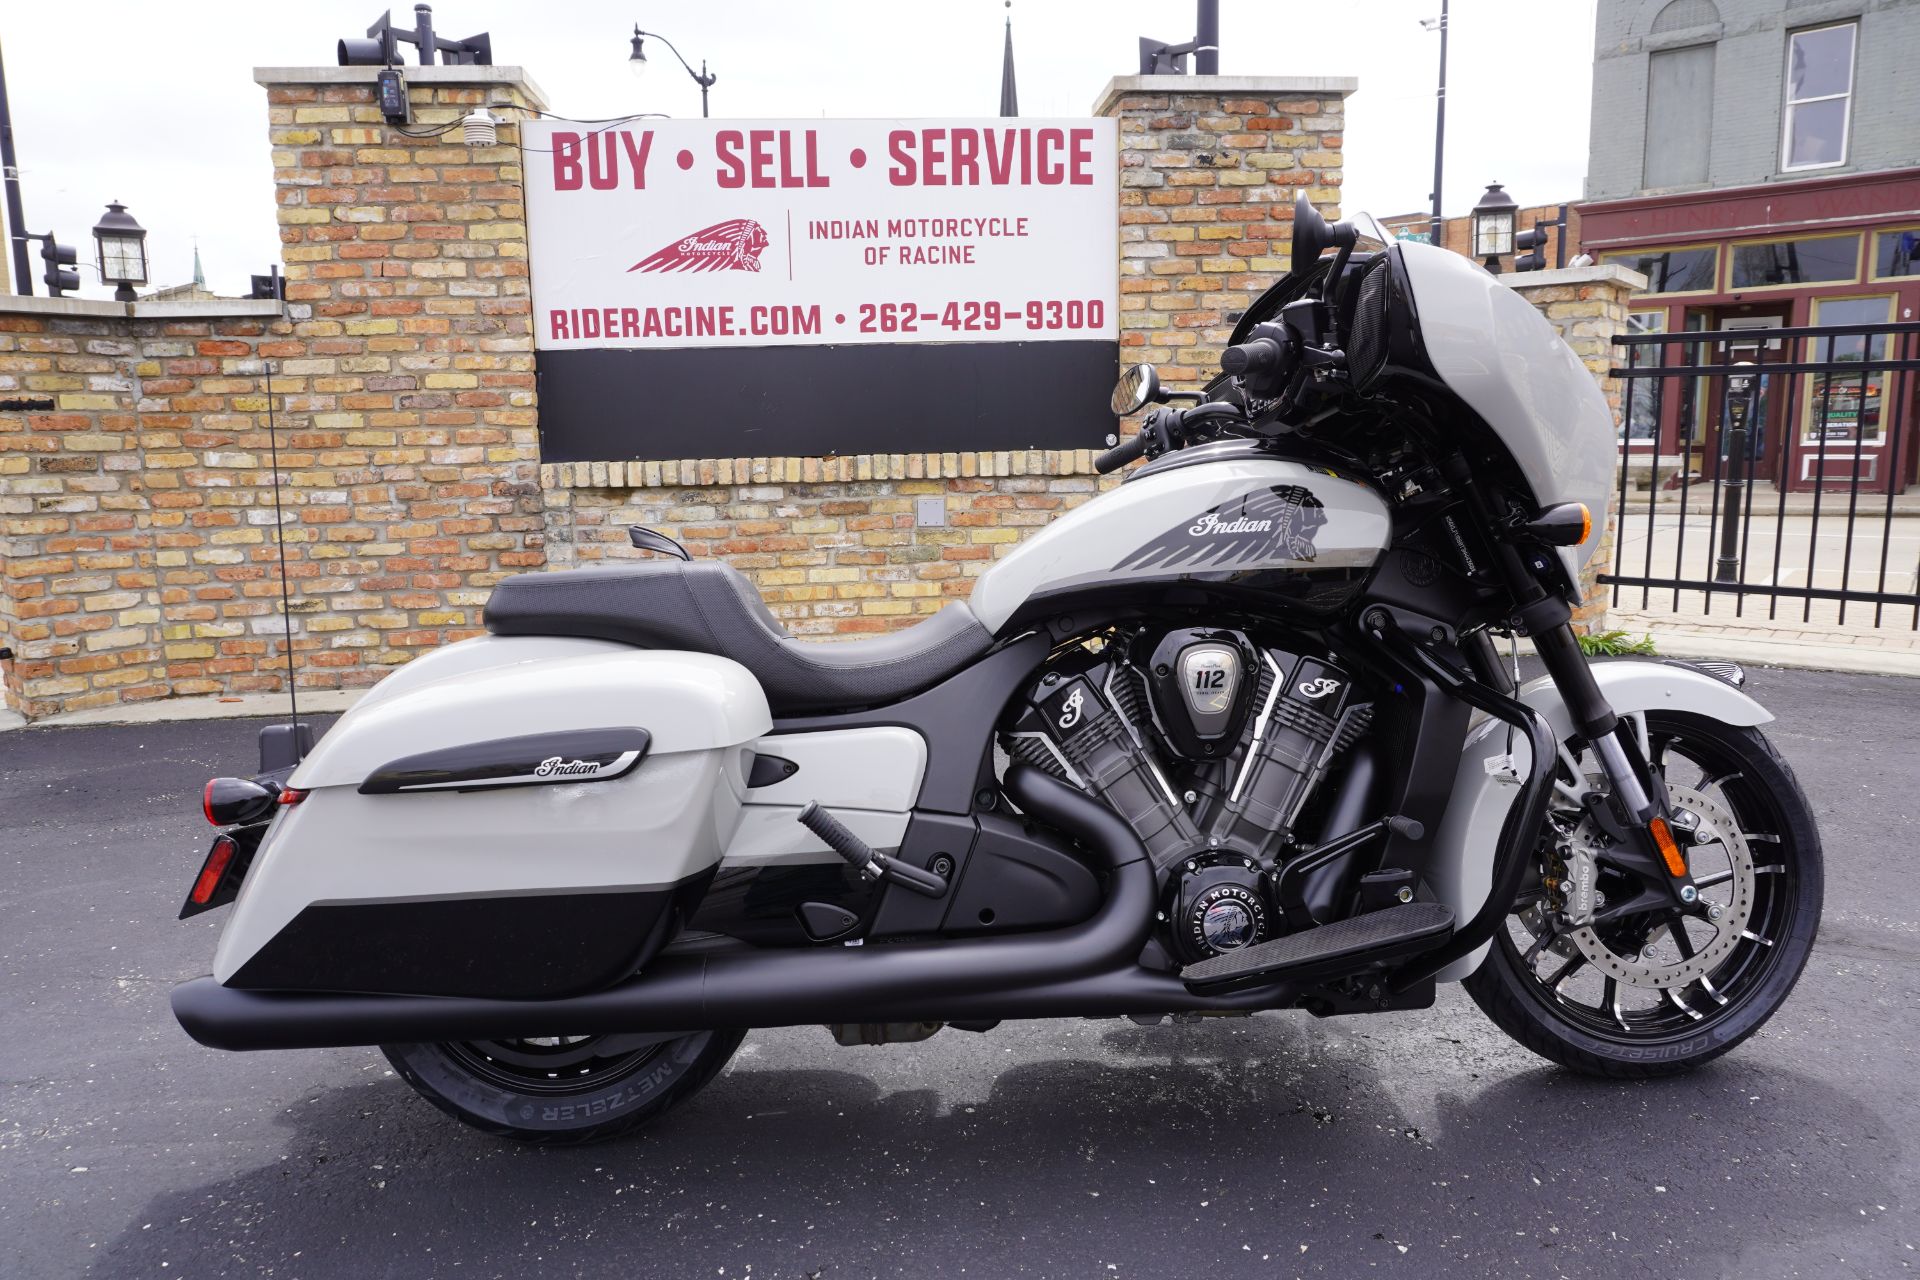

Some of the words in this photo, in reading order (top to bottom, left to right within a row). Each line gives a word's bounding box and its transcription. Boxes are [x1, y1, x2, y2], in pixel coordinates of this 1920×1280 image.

[552, 132, 653, 190] BUY
[716, 131, 829, 188] SELL
[889, 128, 1093, 186] SERVICE
[809, 220, 879, 240] INDIAN
[887, 217, 1028, 238] MOTORCYCLE
[678, 236, 732, 252] Indian
[864, 246, 890, 265] OF
[900, 246, 975, 264] RACINE
[551, 305, 821, 339] RIDERACINE.COM
[860, 300, 1104, 332] 262-429-9300
[1189, 512, 1272, 537] Indian
[1196, 670, 1226, 689] 112
[535, 755, 601, 778] Indian
[1578, 865, 1590, 912] brembo
[541, 1062, 673, 1121] METZELER
